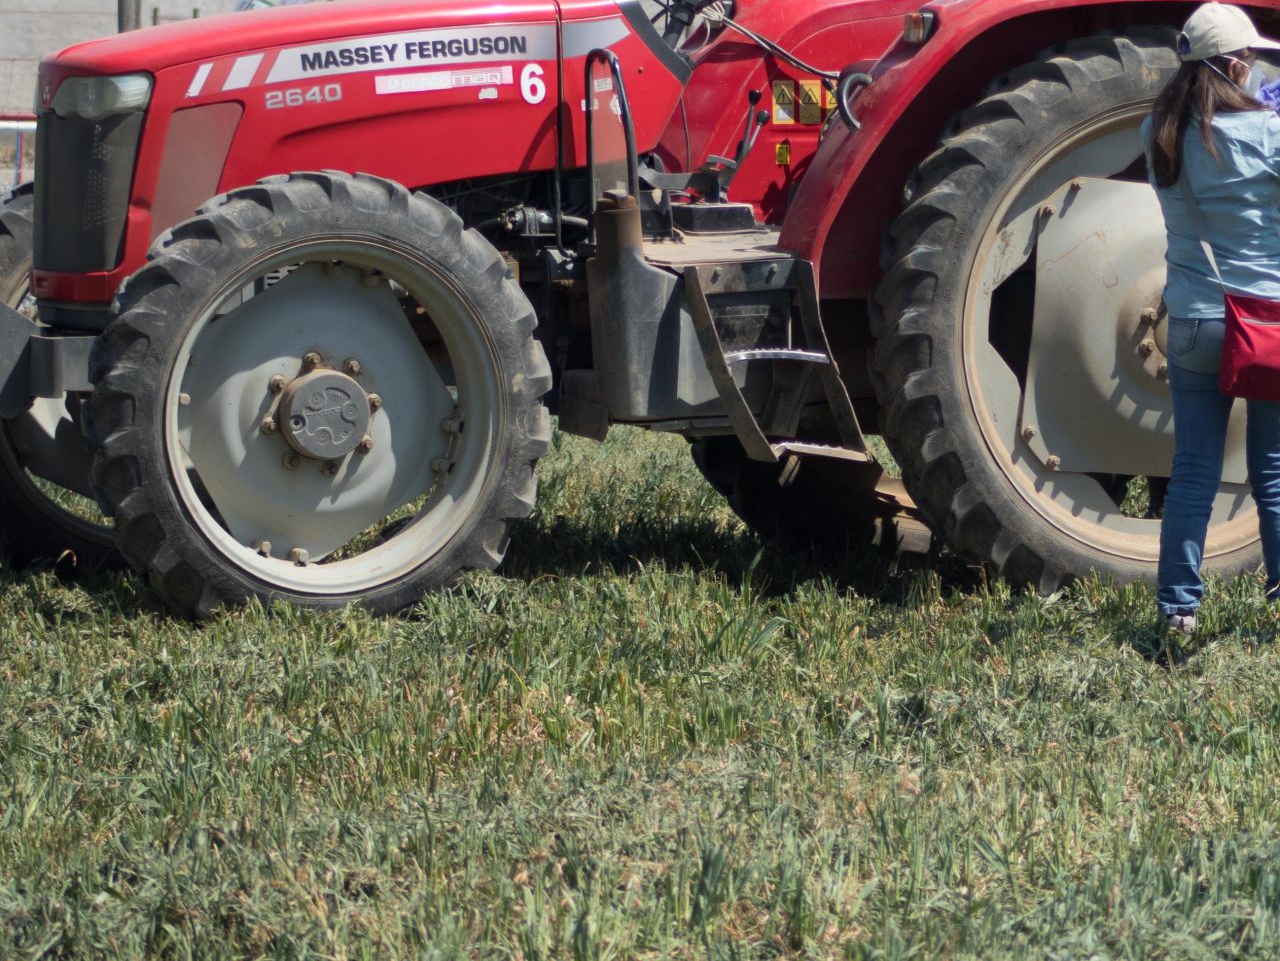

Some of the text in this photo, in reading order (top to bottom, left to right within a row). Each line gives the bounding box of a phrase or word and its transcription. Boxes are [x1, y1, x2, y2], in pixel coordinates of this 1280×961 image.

[301, 35, 527, 72] MASSEY FERGUSON
[265, 82, 342, 111] 2640
[520, 62, 547, 105] 6
